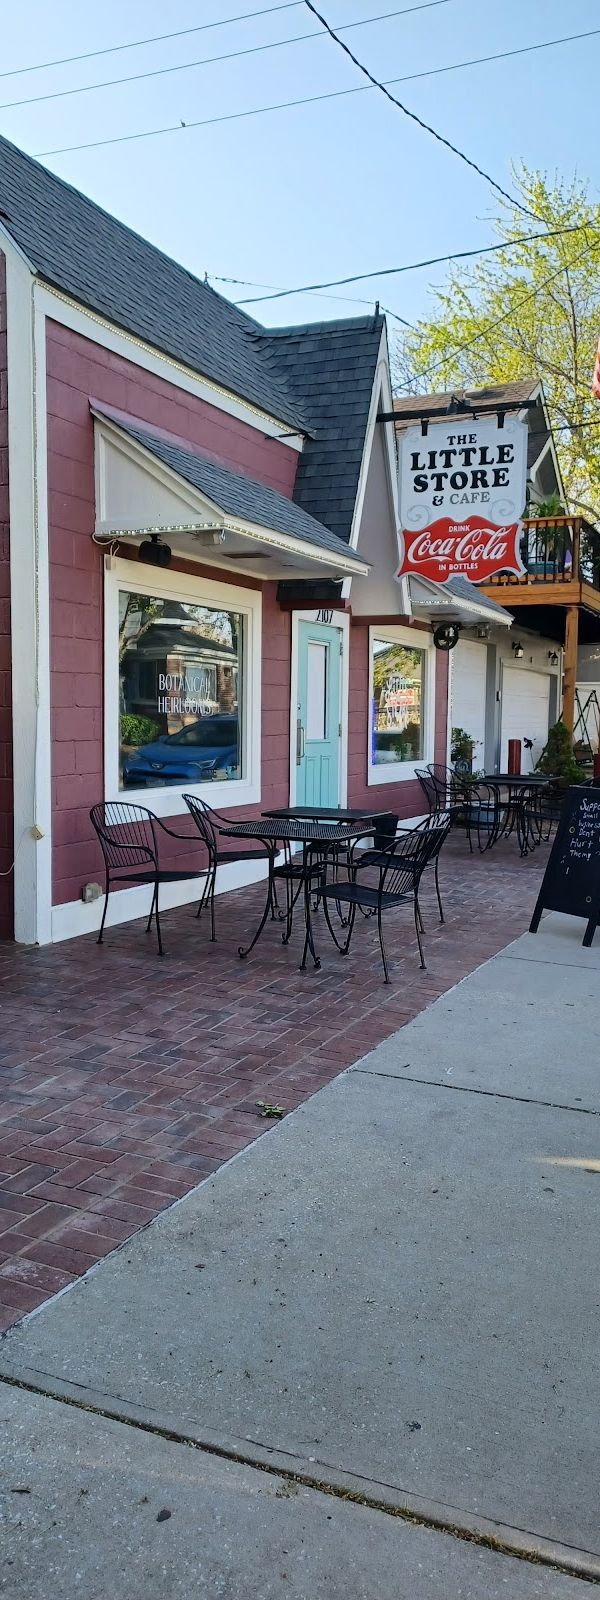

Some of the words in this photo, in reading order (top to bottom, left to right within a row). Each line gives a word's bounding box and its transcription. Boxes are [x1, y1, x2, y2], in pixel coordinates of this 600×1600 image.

[447, 433, 478, 446] THE
[410, 443, 515, 471] LITTLE
[413, 467, 510, 493] STORE
[432, 495, 444, 507] &
[449, 491, 491, 505] CAFE
[448, 524, 471, 533] DRINK
[407, 526, 513, 564] Coca-Cola
[448, 562, 479, 571] BOTTLES
[315, 609, 334, 624] 2107
[158, 673, 209, 693] BOTANICAL
[570, 838, 594, 849] Hurt
